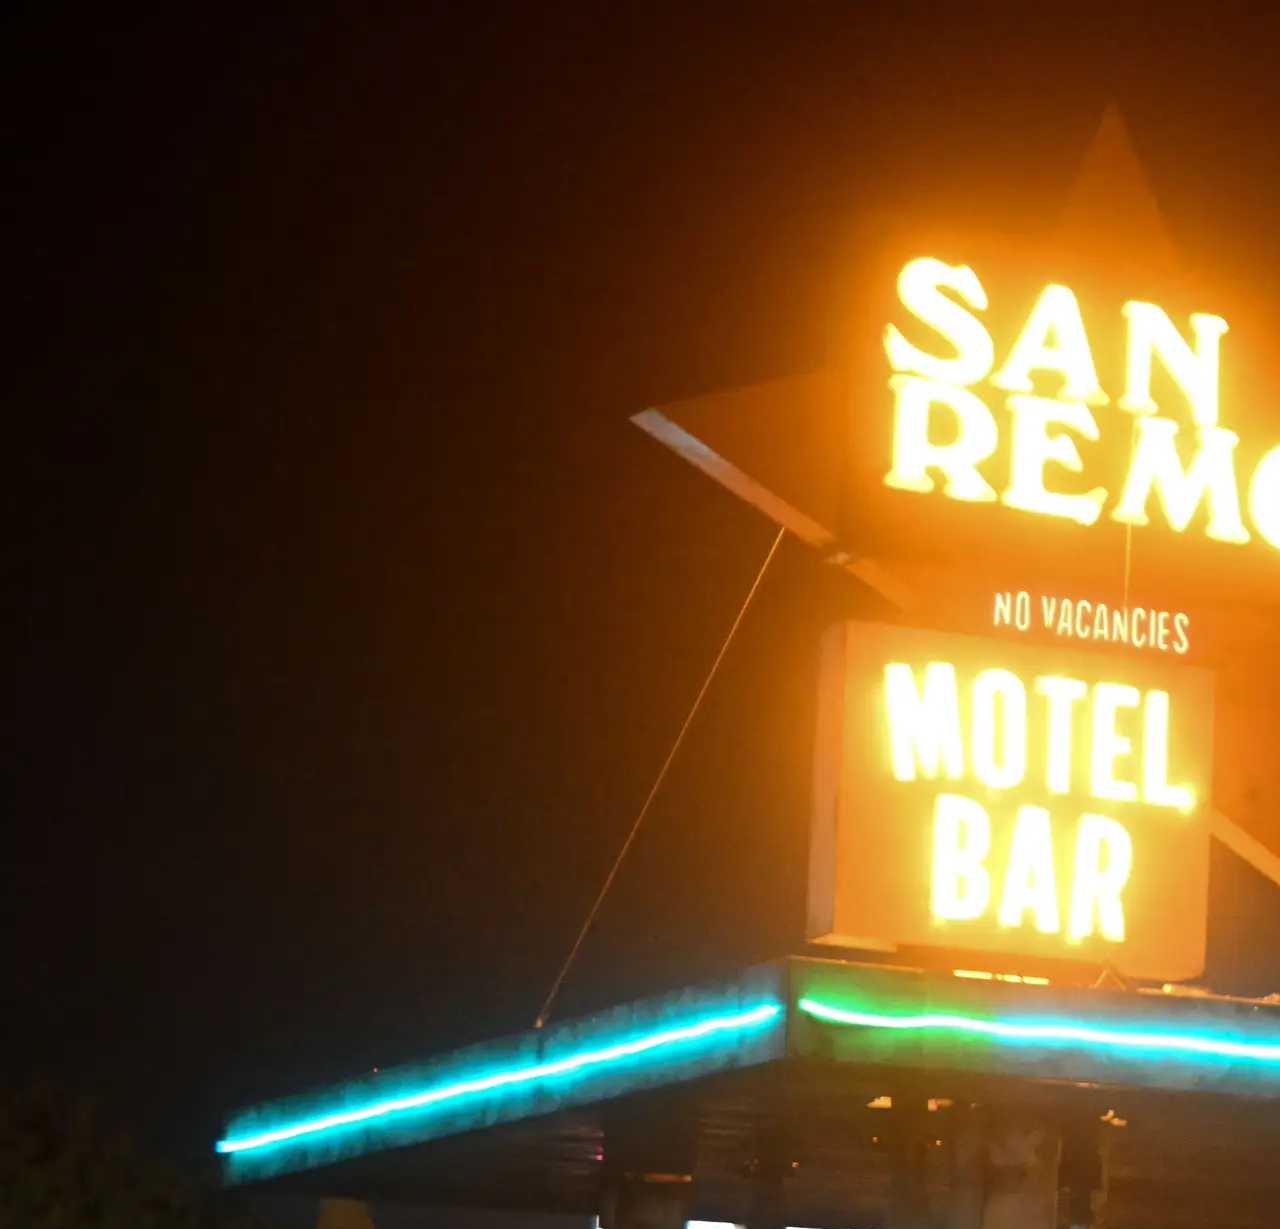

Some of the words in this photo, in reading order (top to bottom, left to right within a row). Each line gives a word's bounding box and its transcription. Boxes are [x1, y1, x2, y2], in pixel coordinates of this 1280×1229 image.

[883, 257, 1229, 426] SAN
[993, 591, 1030, 632] NO
[1041, 595, 1190, 655] VACANCIES
[883, 660, 1197, 812] MOTEL
[931, 793, 1135, 944] BAR
